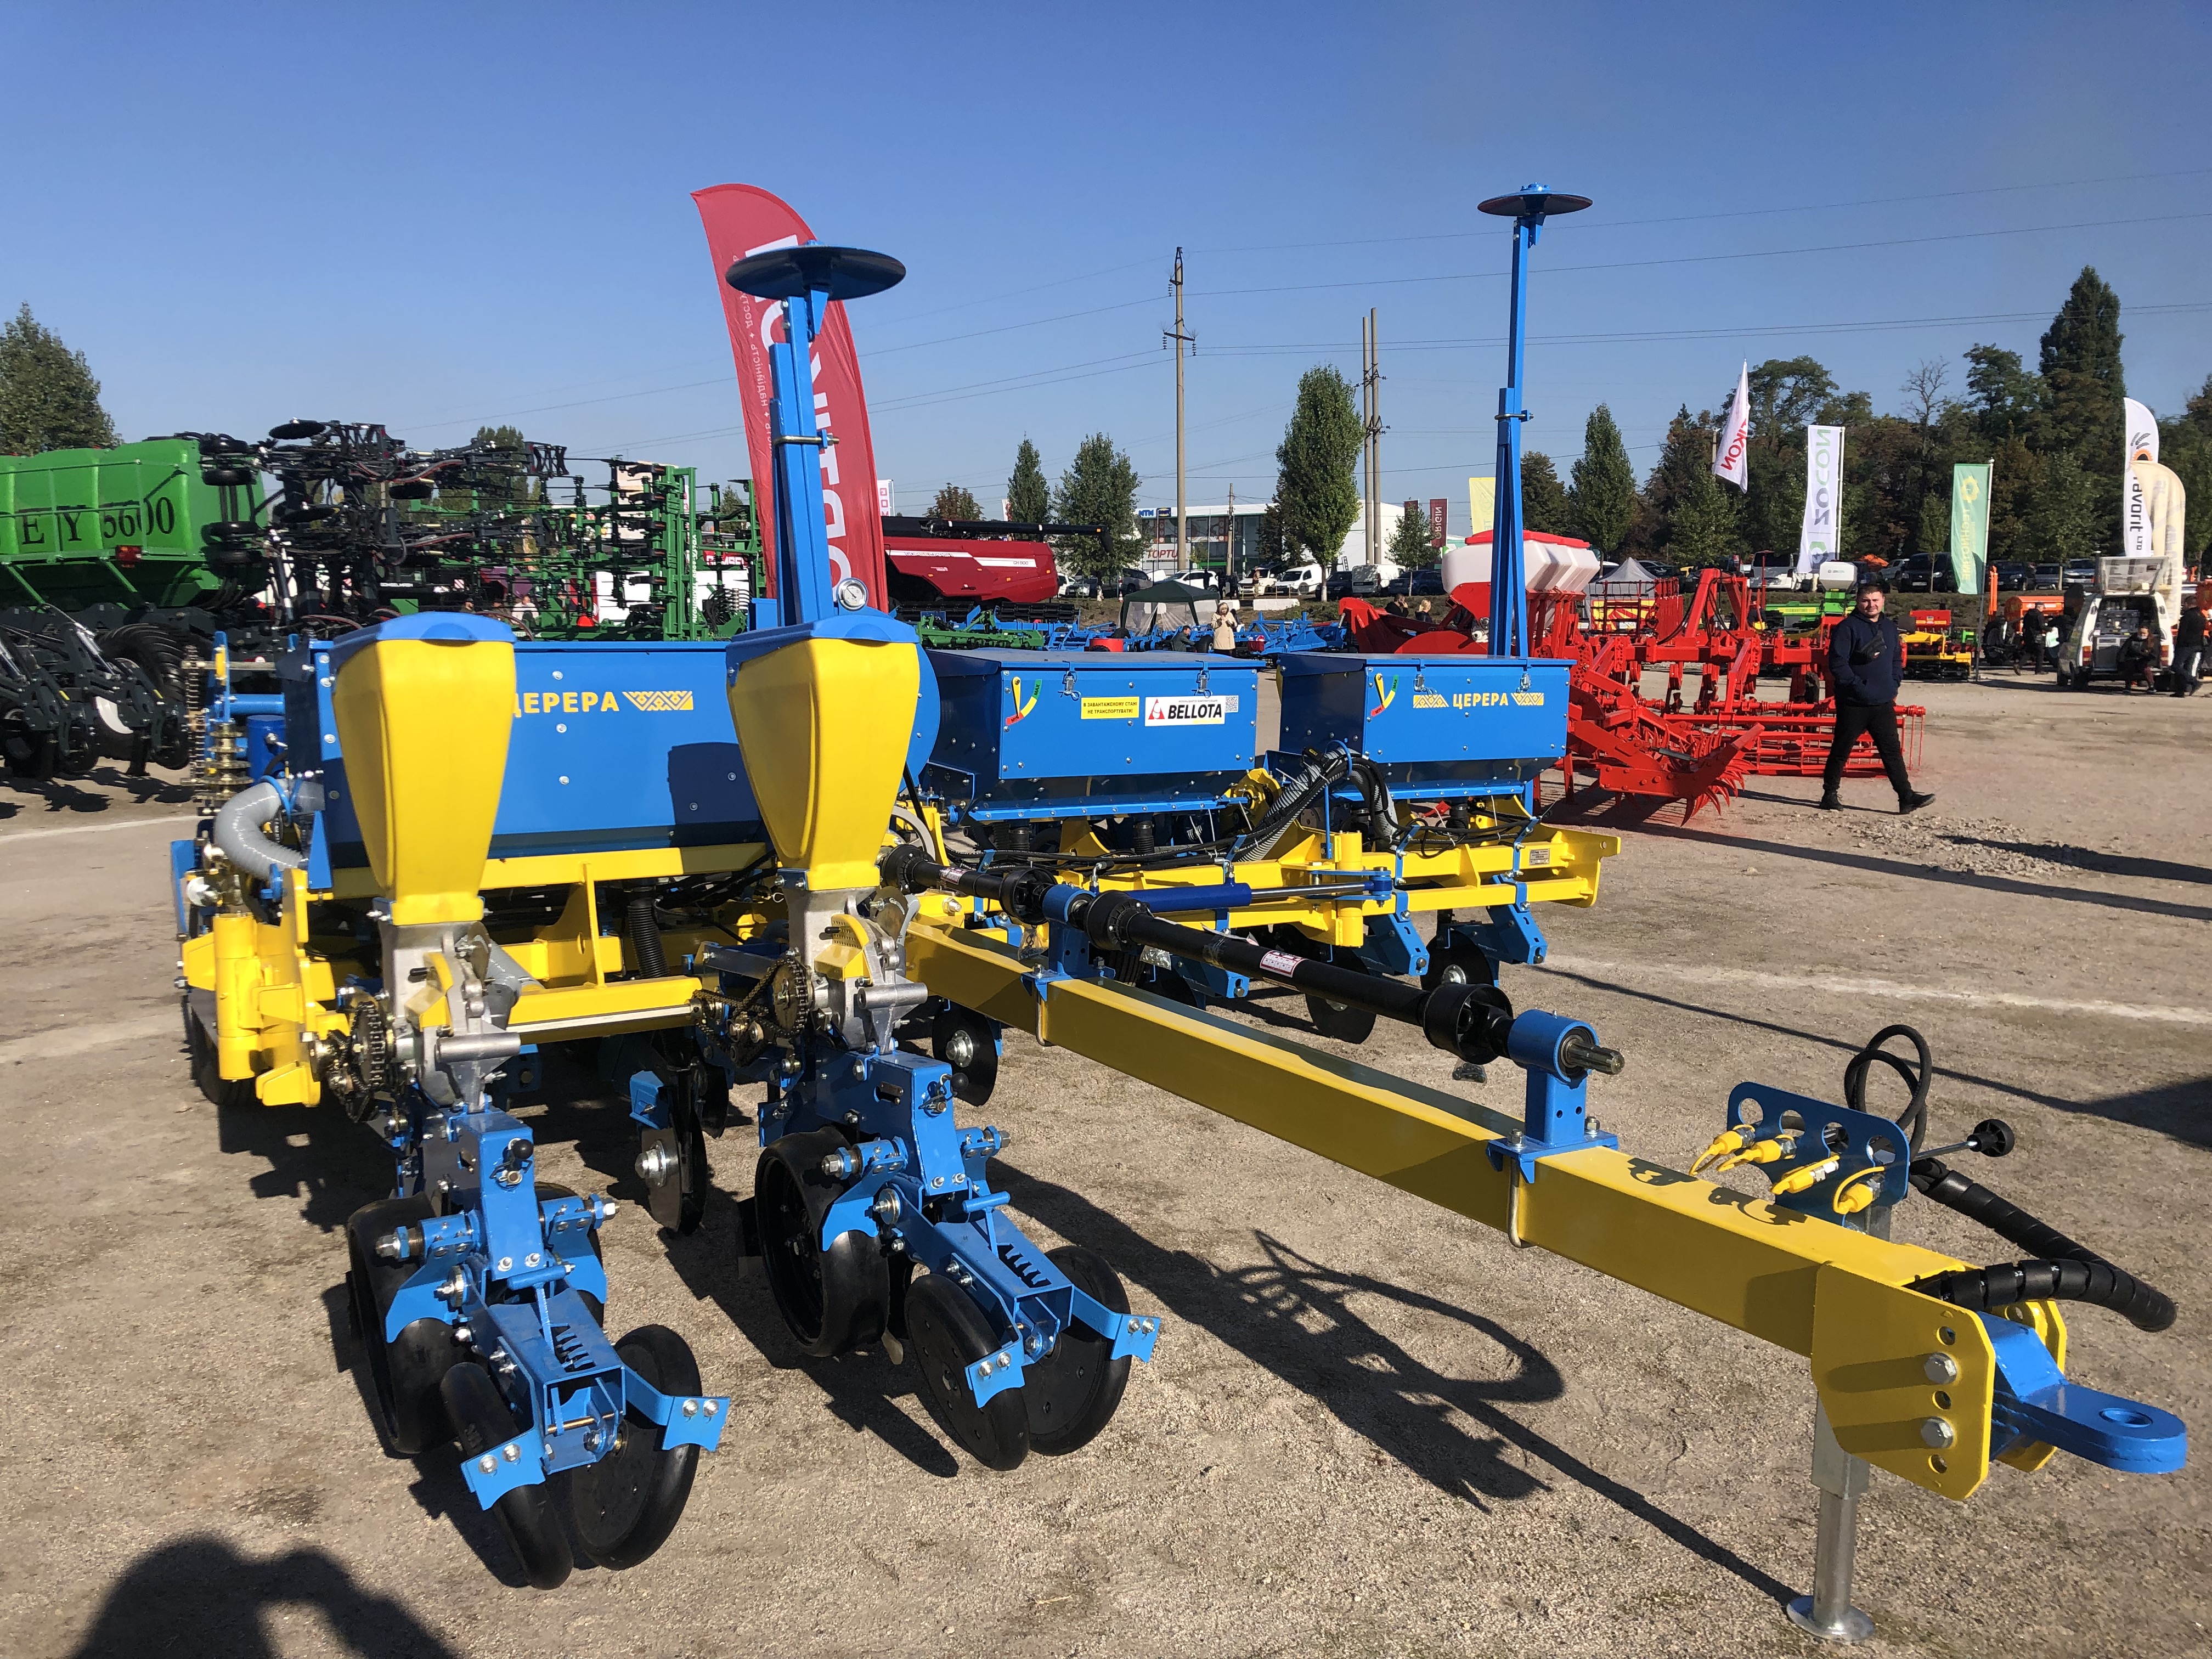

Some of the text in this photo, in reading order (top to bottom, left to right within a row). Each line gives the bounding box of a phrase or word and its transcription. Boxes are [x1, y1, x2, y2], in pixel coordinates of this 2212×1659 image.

[2130, 476, 2143, 532] avorit
[1148, 549, 1178, 558] TOPTU
[1453, 692, 1509, 709] ЦЕРЕРА
[1168, 704, 1222, 719] BELLOTA
